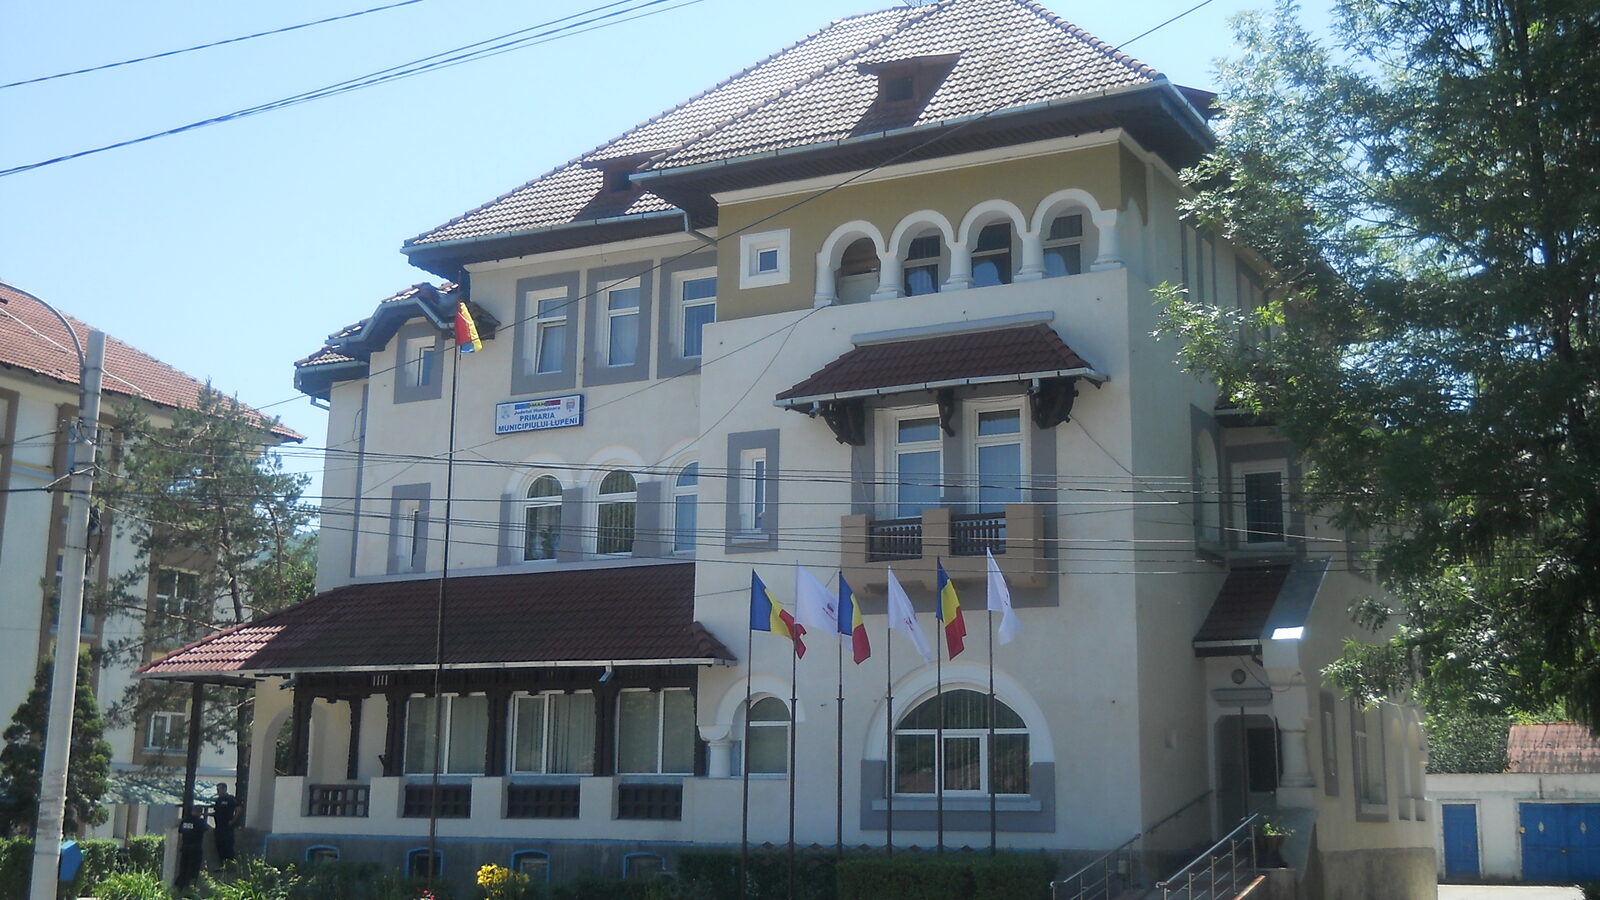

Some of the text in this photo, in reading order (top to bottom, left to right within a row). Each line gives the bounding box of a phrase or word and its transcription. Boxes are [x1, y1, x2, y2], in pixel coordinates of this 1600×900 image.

[519, 412, 555, 421] PRIMARIA
[498, 417, 577, 431] MUNICIPIULUI LUPENI
